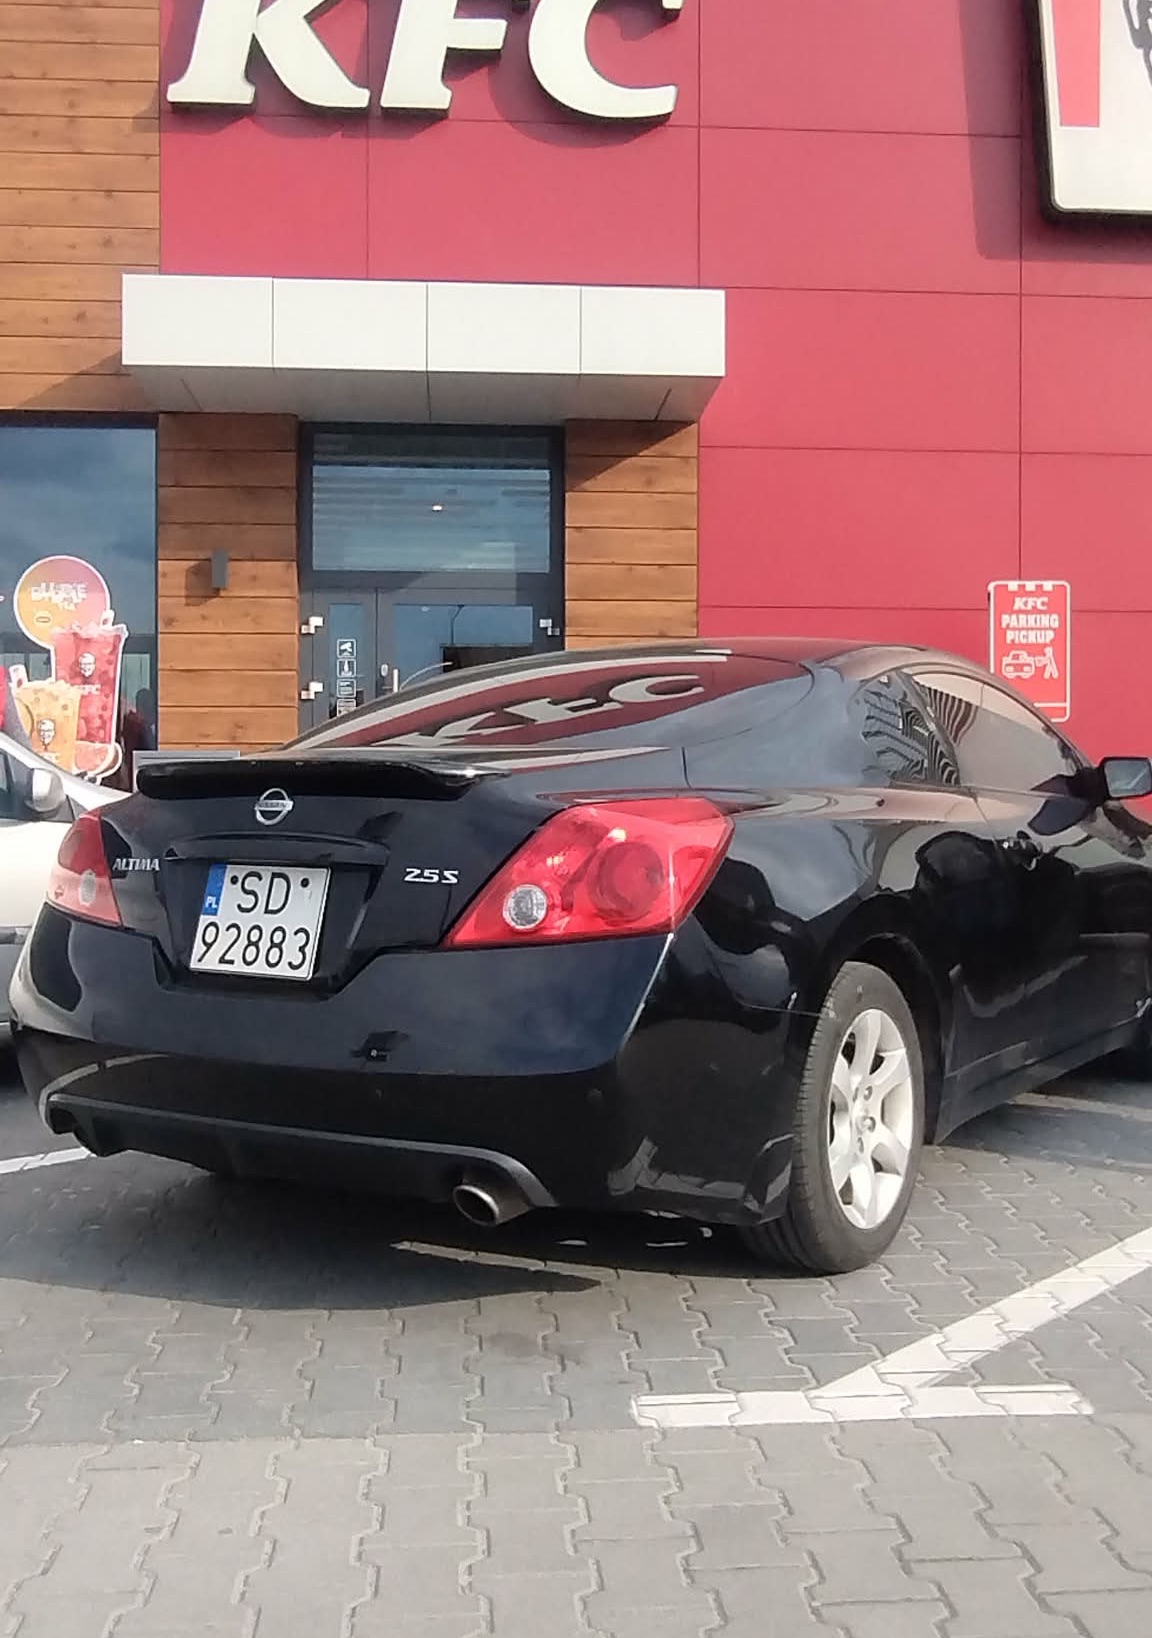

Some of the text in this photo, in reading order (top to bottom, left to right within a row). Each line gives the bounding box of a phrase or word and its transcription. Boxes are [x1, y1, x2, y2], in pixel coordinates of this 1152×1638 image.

[167, 0, 679, 118] KFC
[1013, 597, 1048, 610] KFC
[1001, 614, 1059, 628] PARKING
[1006, 630, 1055, 644] PICKUP
[112, 858, 160, 871] ALTIMA
[237, 871, 291, 915] SD
[205, 896, 217, 908] PL
[197, 921, 310, 970] 92883
